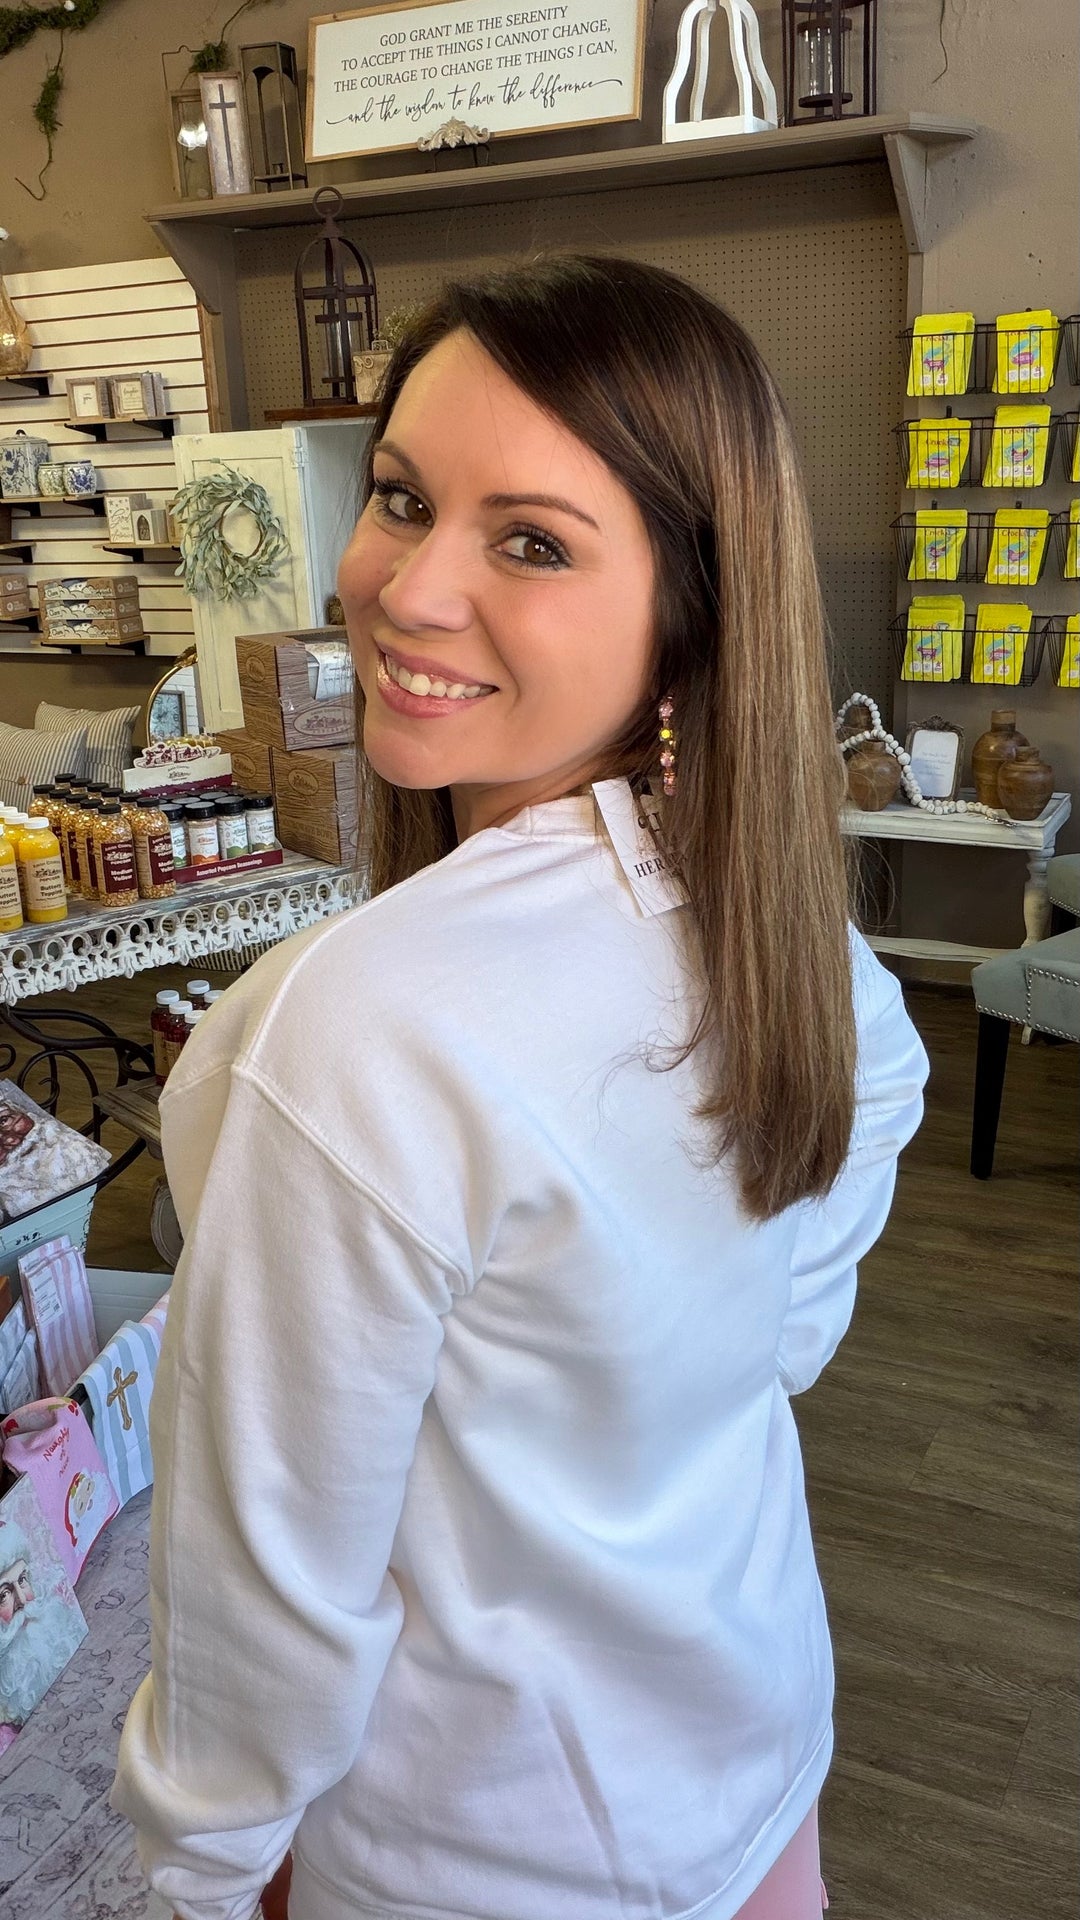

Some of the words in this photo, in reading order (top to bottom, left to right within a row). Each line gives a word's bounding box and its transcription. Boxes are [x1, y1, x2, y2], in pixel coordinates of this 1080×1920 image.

[341, 58, 358, 71] TO
[360, 50, 406, 69] ACCEPT
[409, 46, 433, 60] THE
[436, 38, 483, 57] THINGS
[494, 28, 549, 48] CANNOT
[552, 19, 611, 39] CHANGE,
[380, 32, 406, 46] GOD
[409, 24, 452, 42] GRANT
[454, 21, 474, 35] ME
[477, 16, 502, 31] THE
[505, 5, 568, 27] SERENITY
[334, 78, 358, 92] THE
[360, 69, 417, 89] COURAGE
[420, 66, 438, 80] TO
[440, 58, 493, 77] CHANGE
[496, 54, 522, 69] THE
[525, 46, 574, 64] THINGS
[586, 40, 617, 56] CAN,
[332, 97, 374, 124] and
[375, 94, 401, 122] the
[405, 87, 446, 122] wisdom
[447, 84, 467, 110] to
[468, 81, 496, 110] know
[497, 75, 526, 105] the
[529, 72, 612, 109] difference
